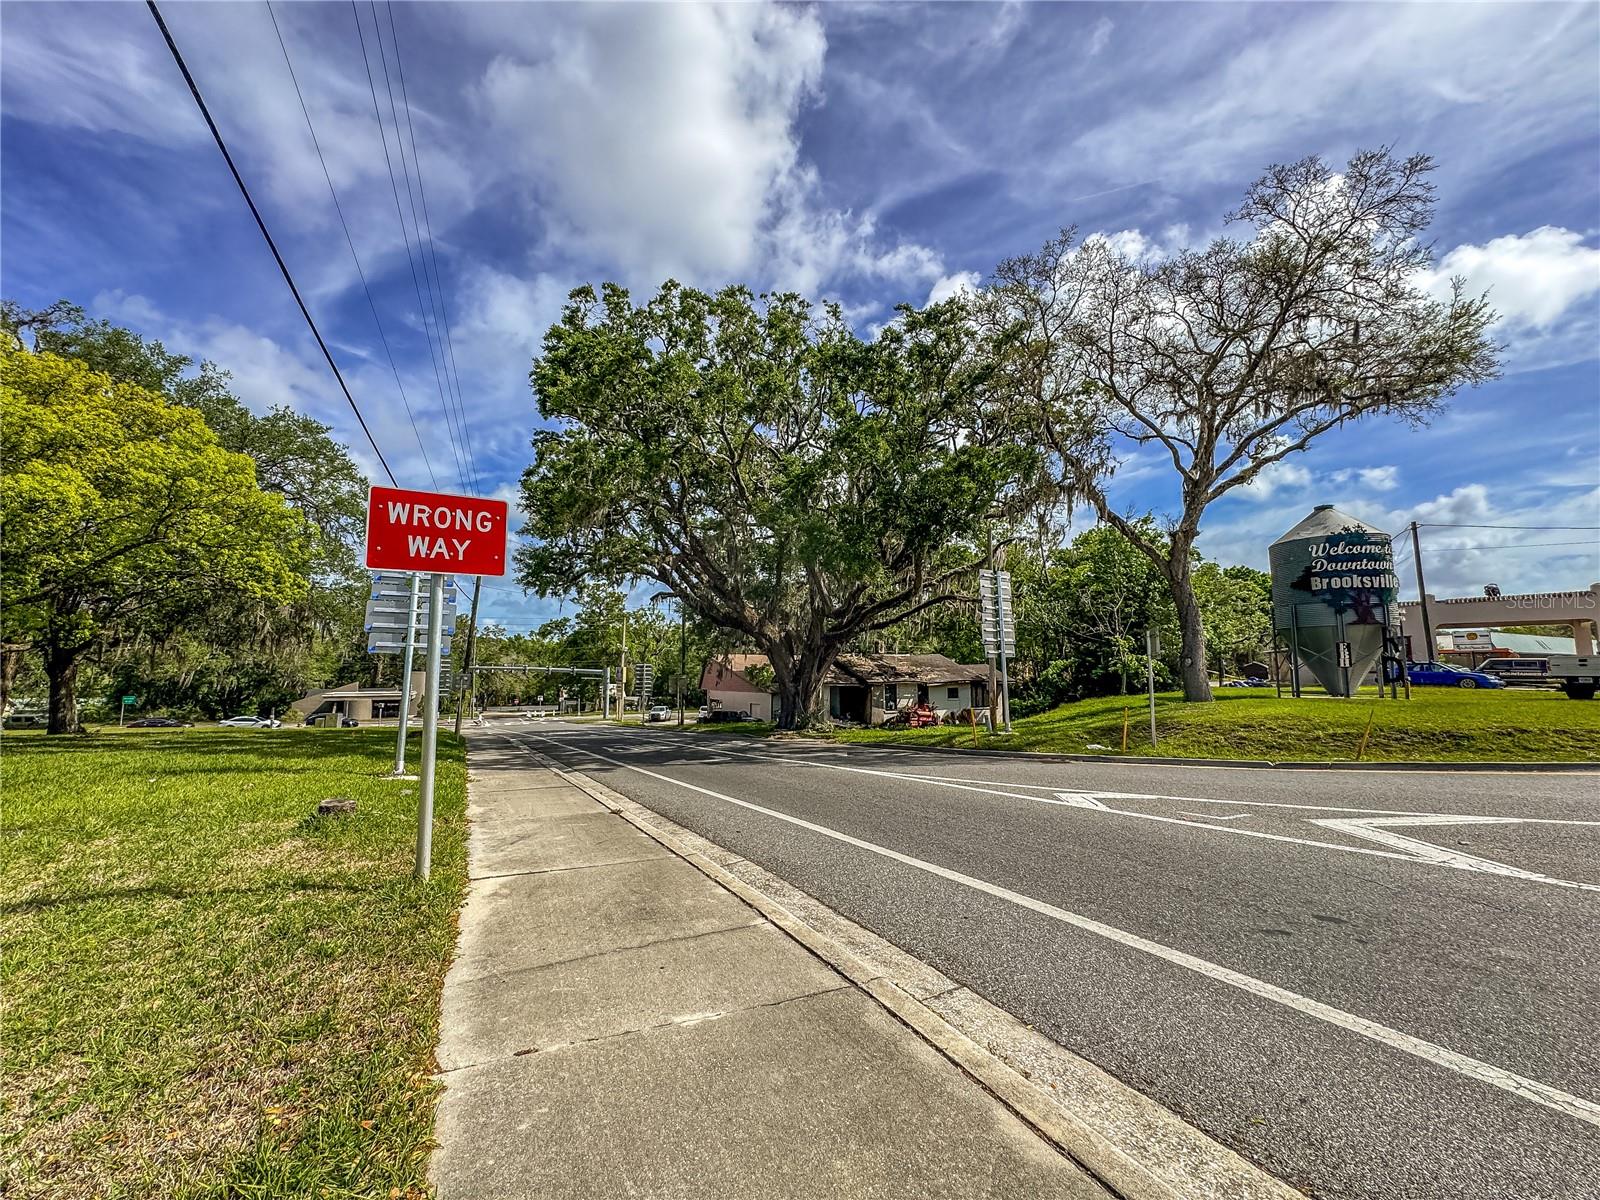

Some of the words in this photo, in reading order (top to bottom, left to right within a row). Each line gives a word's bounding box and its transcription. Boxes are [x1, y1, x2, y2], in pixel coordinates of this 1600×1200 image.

[387, 501, 493, 533] WRONG
[407, 535, 472, 561] WAY
[1308, 541, 1383, 557] Welcome
[1311, 558, 1393, 572] Downtown
[1310, 574, 1399, 590] Brooksville
